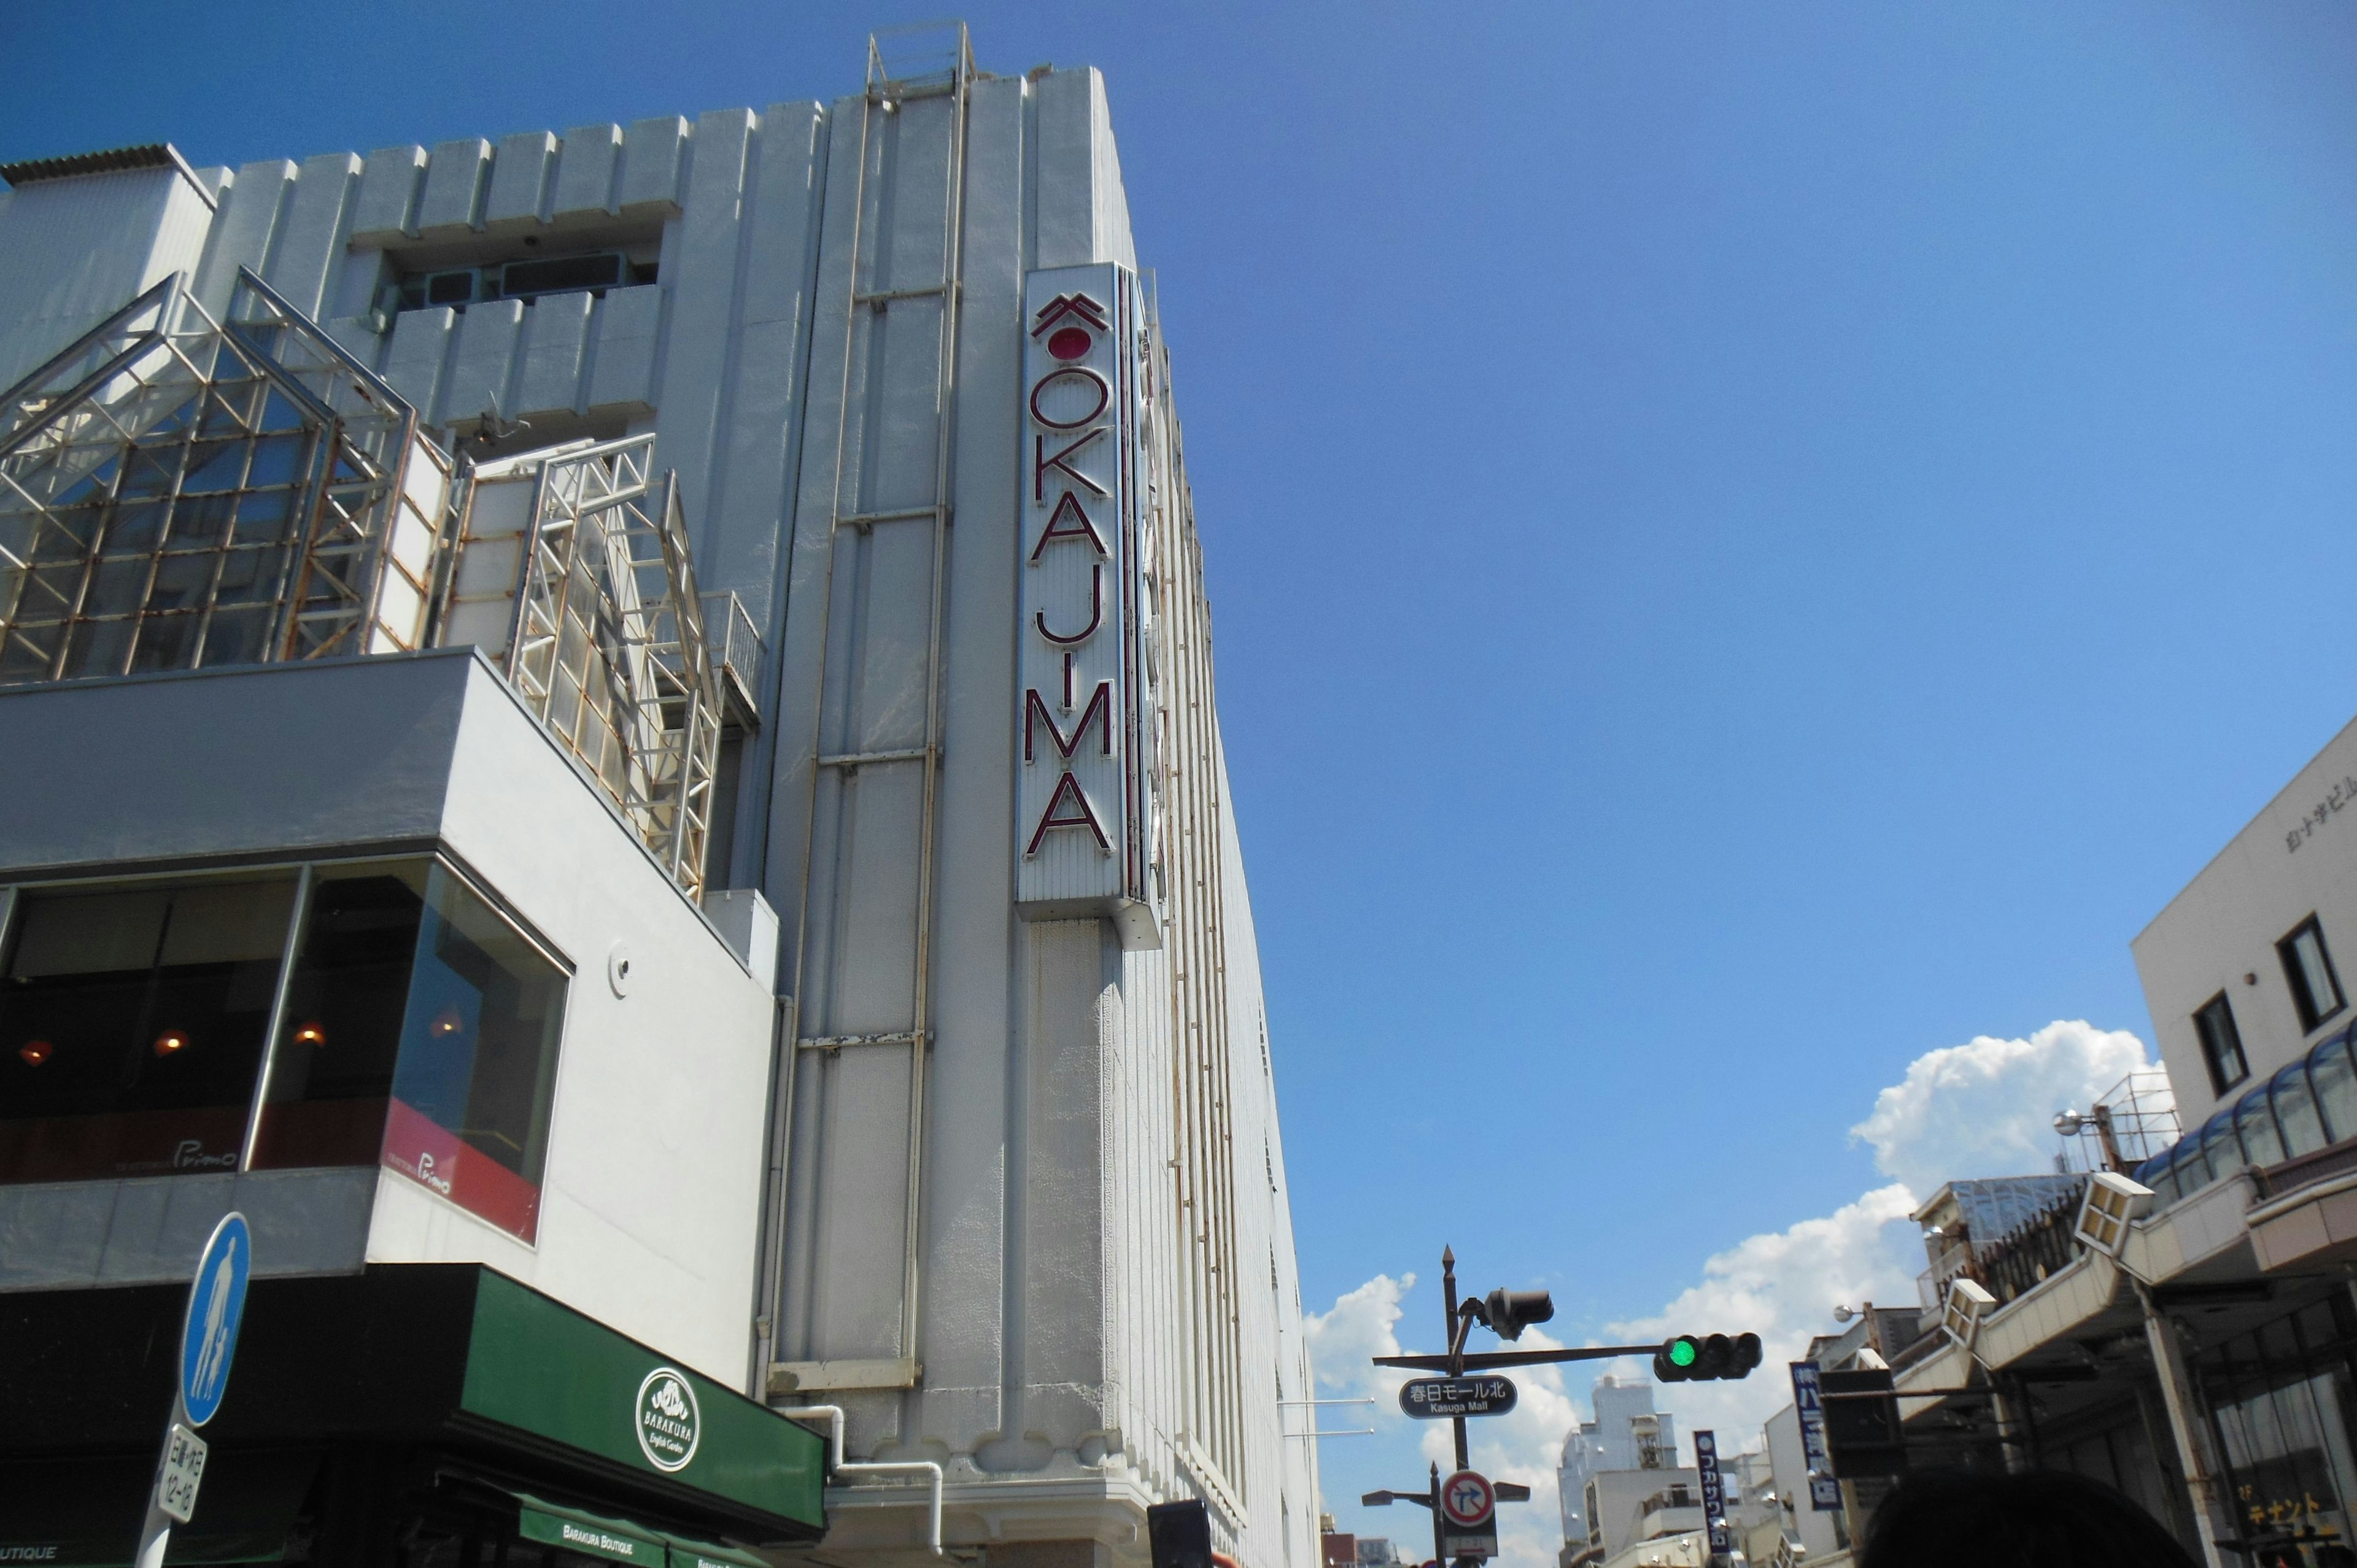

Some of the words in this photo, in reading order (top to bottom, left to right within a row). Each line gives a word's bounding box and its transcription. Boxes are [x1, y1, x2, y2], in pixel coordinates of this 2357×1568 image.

[1024, 368, 1116, 857] OKAJIMA
[176, 1141, 237, 1167] Primo
[418, 1153, 450, 1194] Primo
[1411, 1381, 1506, 1402] 春日モール北
[1431, 1404, 1465, 1413] Kasuga
[1468, 1402, 1488, 1411] Mall
[644, 1411, 691, 1442] BARAKURA
[649, 1432, 666, 1447] English
[667, 1439, 684, 1454] Garden
[2250, 1493, 2319, 1523] テナント
[563, 1525, 599, 1546] BARAKURA
[600, 1535, 633, 1555] BOUTIQUE
